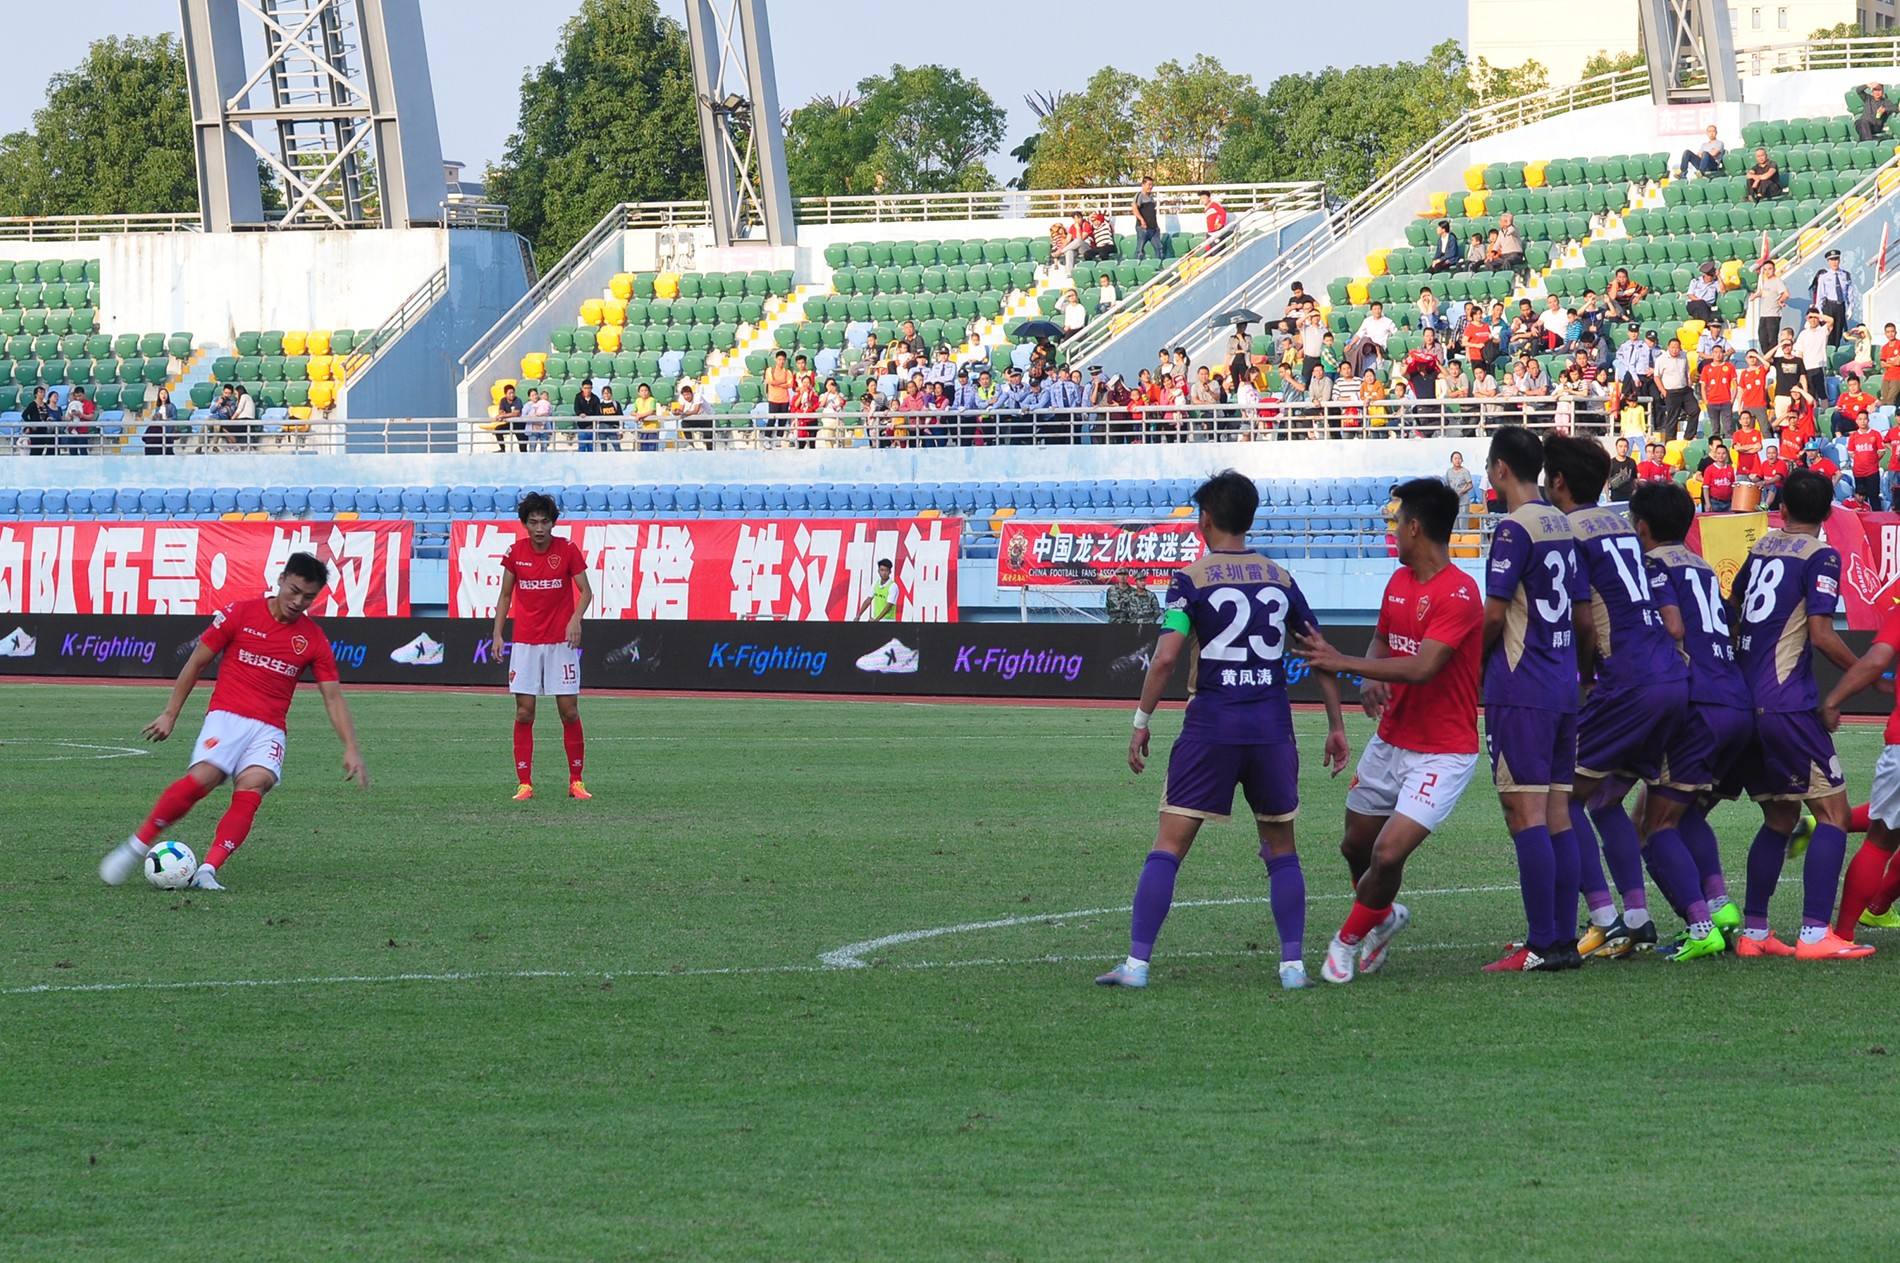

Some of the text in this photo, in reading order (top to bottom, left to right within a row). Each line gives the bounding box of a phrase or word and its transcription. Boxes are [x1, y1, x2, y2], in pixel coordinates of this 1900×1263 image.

[1032, 531, 1201, 563] 中国龙之队球迷会
[730, 521, 951, 622] 铁汉加油
[1028, 568, 1047, 577] CHINA
[1050, 568, 1078, 577] FOOTBALL
[1081, 568, 1097, 578] FANS
[1152, 568, 1169, 577] TEAM
[1205, 562, 1282, 583] 深圳雷曼
[1601, 536, 1651, 602] 17
[1685, 567, 1730, 637] 16
[1739, 558, 1784, 623] 18
[243, 627, 267, 639] KELME
[1201, 586, 1289, 661] 23
[61, 633, 156, 665] K-Fighting
[708, 642, 827, 677] K-Fighting
[954, 646, 1083, 682] K-Fighting
[563, 664, 576, 681] 15
[1221, 668, 1273, 686] 黄凤涛
[1419, 772, 1439, 797] 2
